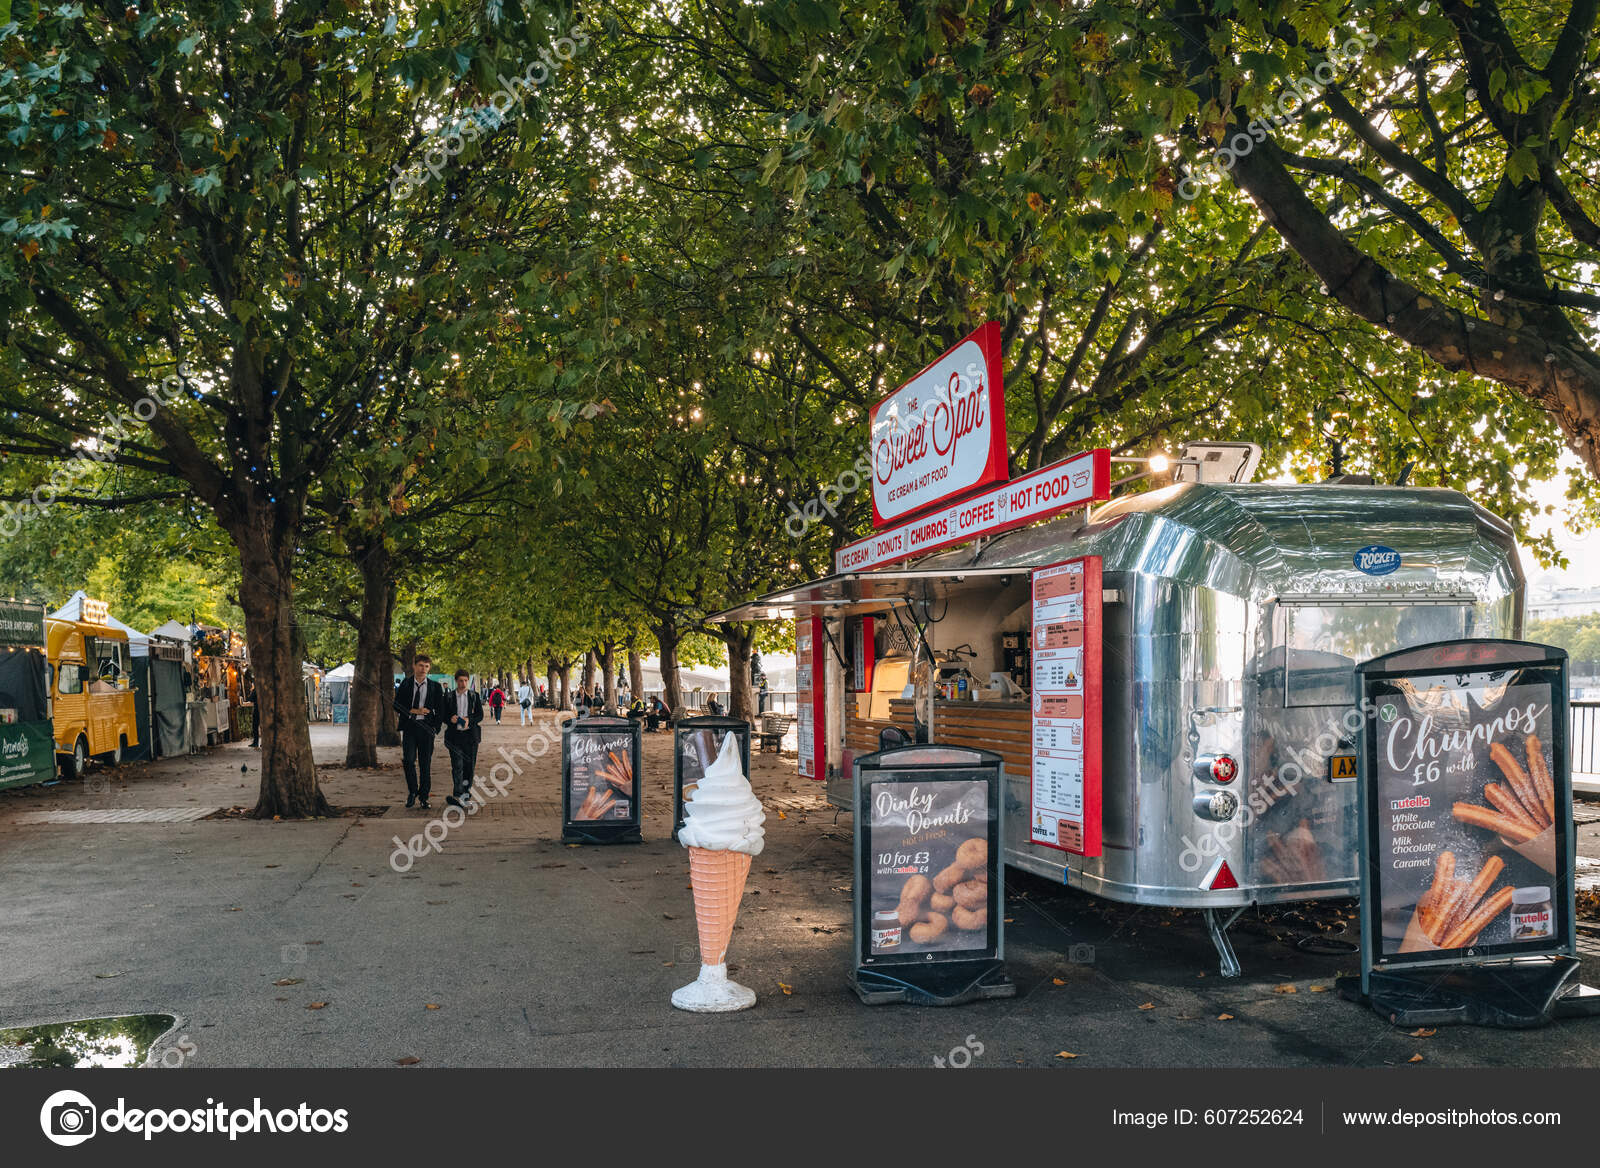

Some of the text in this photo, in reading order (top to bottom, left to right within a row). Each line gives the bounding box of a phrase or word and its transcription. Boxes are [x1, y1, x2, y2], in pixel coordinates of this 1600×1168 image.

[907, 397, 918, 411] THE
[876, 372, 984, 485] Sweet Spot
[887, 465, 948, 504] ICE CREAM & HOT FOOD
[841, 475, 1070, 569] ICE CREAM DONUTS CHURROS COFFEE HOT FOOD
[1359, 552, 1397, 569] ROCKET
[1387, 703, 1549, 772] Churros
[1412, 752, 1480, 787] £6 with
[876, 786, 938, 817] Dinky
[1391, 796, 1431, 809] nutella
[906, 802, 975, 835] Donuts
[1392, 813, 1418, 823] White
[1392, 820, 1435, 832] chocolate
[1392, 837, 1412, 846] Milk
[1392, 843, 1436, 854] chocolate
[878, 851, 930, 868] 10 for £3
[1393, 858, 1430, 868] Caramel
[893, 866, 918, 874] nutella
[1514, 912, 1549, 924] nutella
[879, 928, 901, 938] nutella
